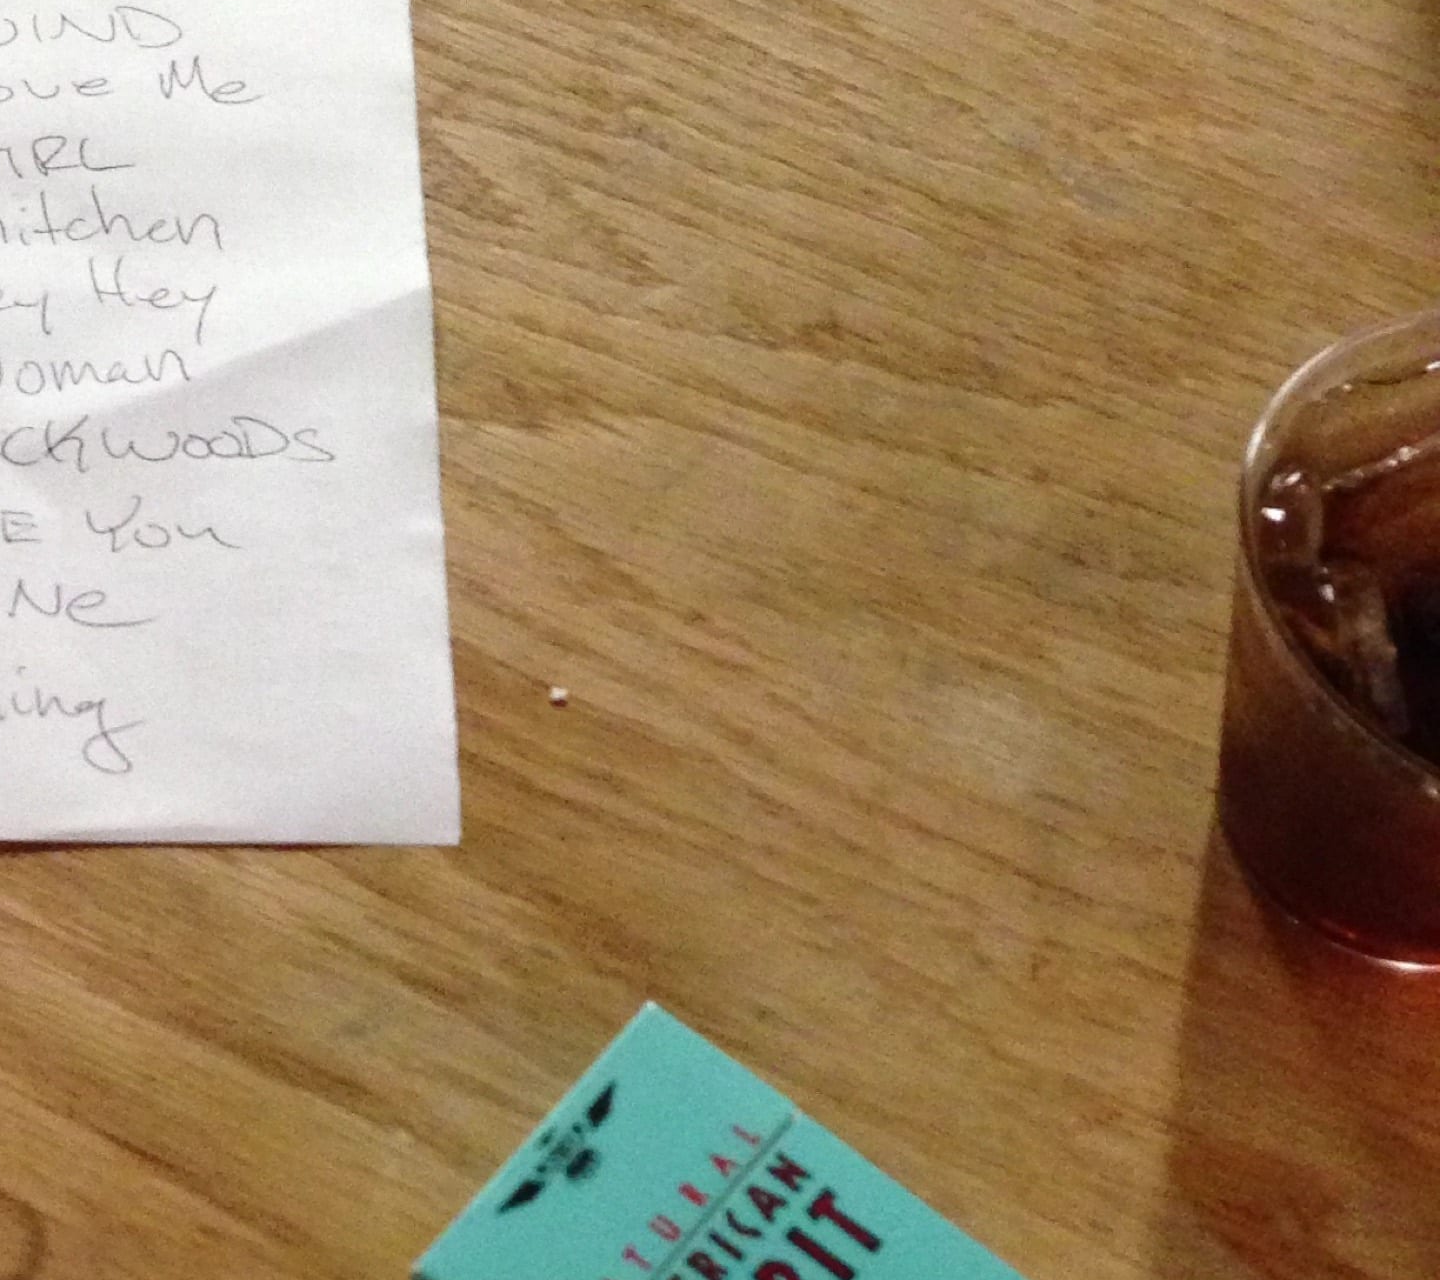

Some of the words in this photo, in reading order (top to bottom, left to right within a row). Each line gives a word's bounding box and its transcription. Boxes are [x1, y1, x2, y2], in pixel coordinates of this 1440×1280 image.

[158, 54, 264, 106] Me
[88, 255, 220, 345] Hey
[86, 494, 244, 553] You
